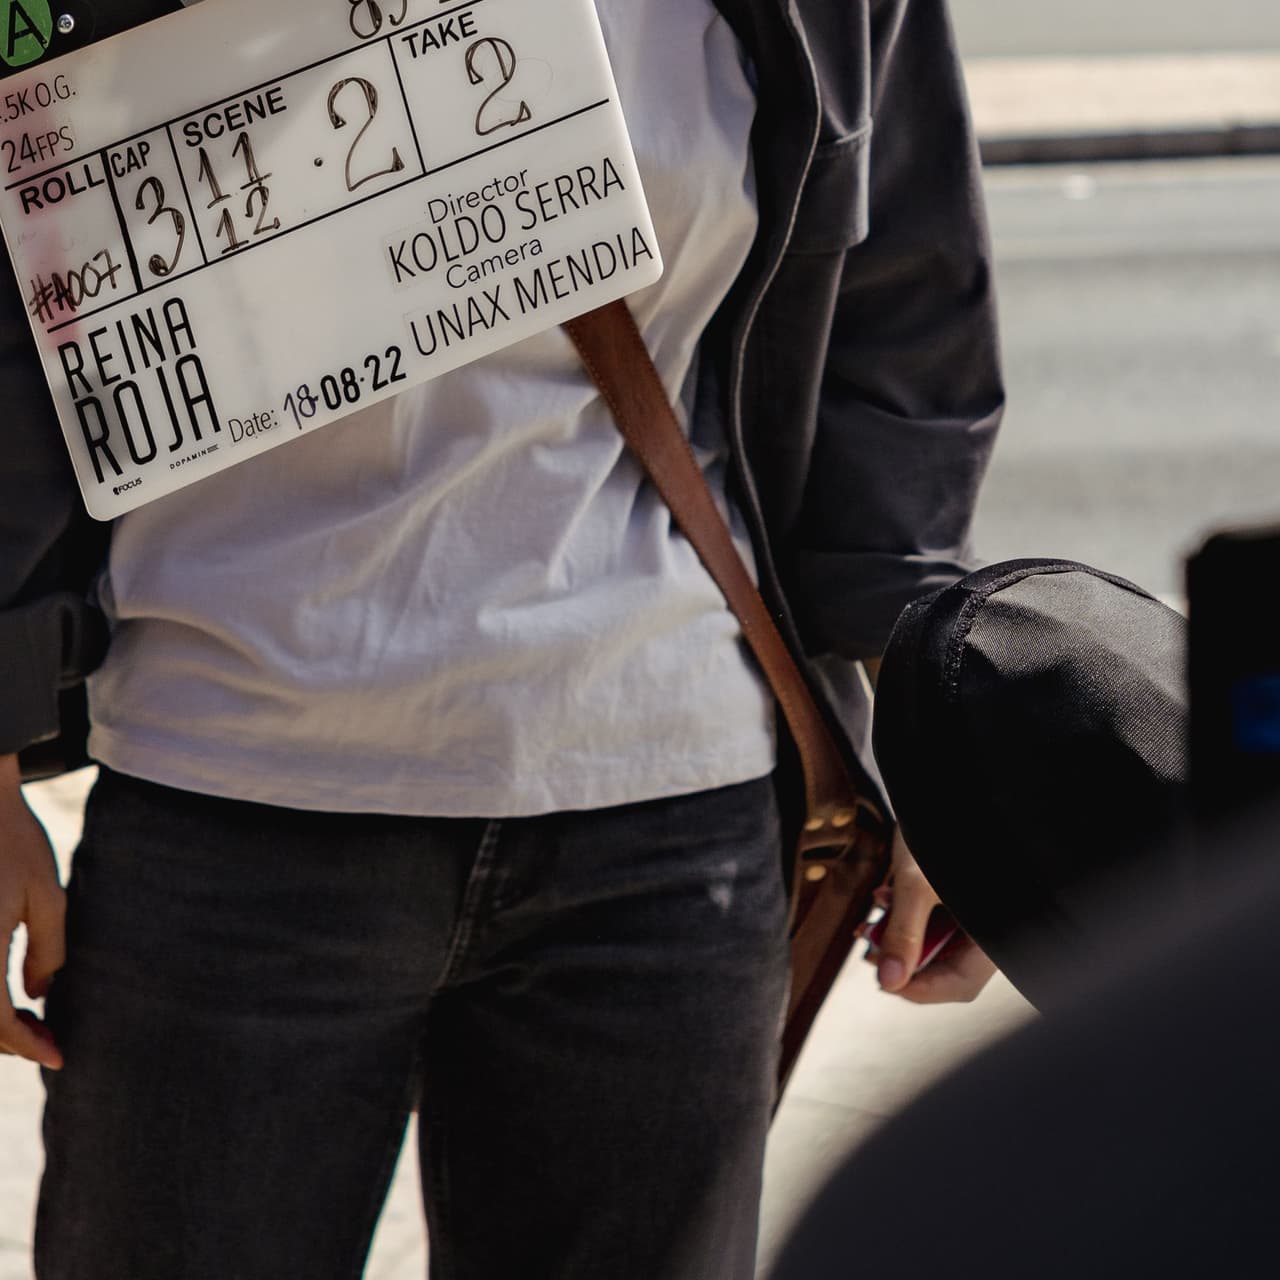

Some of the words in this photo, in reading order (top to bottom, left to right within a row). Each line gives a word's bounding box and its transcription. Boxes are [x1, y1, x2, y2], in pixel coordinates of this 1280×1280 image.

[7, 0, 48, 57] A
[401, 11, 478, 58] TAKE
[183, 86, 287, 148] SCENE
[465, 37, 532, 136] 2
[19, 163, 105, 215] ROLL
[110, 140, 151, 178] CAP
[135, 176, 186, 277] 3
[215, 185, 281, 255] 12
[388, 204, 507, 283] KOLDO
[514, 157, 625, 230] SERRA
[427, 169, 528, 224] Director
[410, 284, 510, 357] UNAX
[513, 226, 654, 314] MENDIA
[446, 238, 543, 289] Camera
[57, 296, 197, 400] REINA
[74, 353, 222, 484] ROJA
[228, 409, 278, 443] Date:
